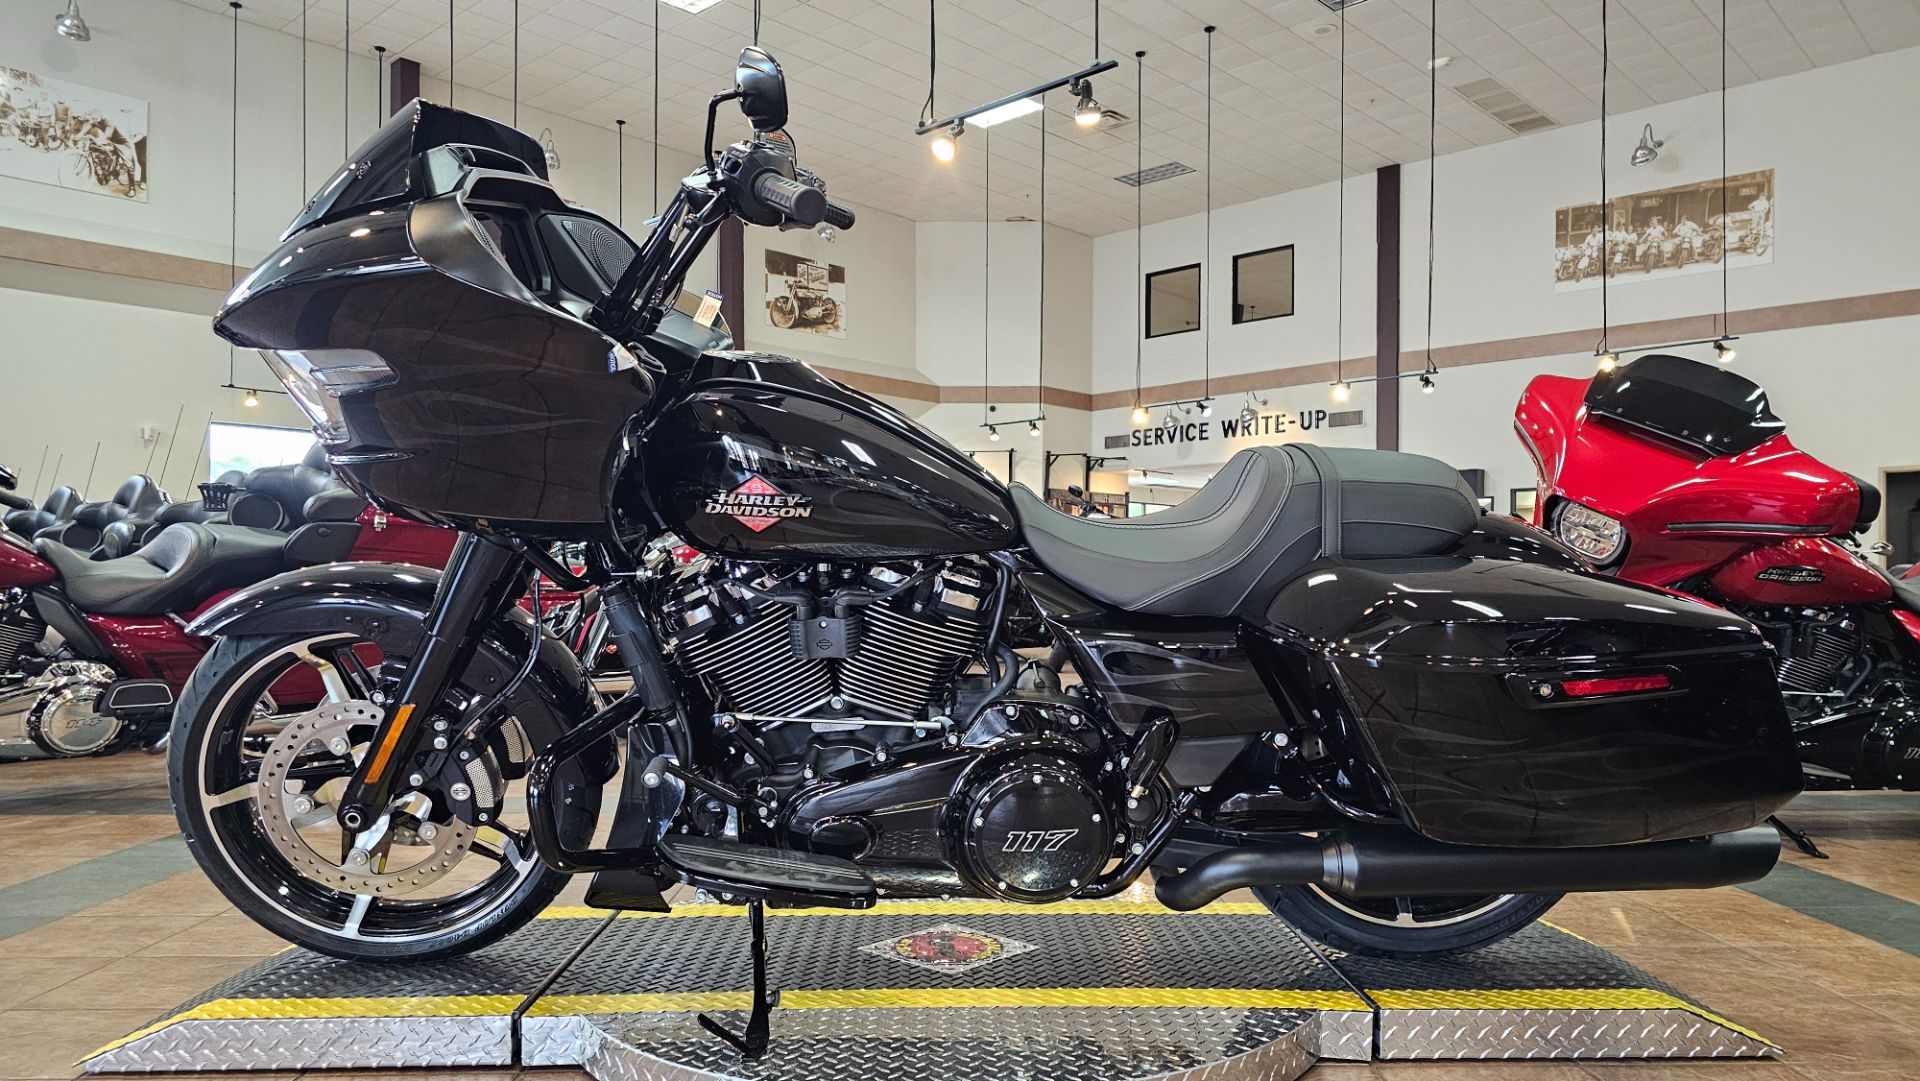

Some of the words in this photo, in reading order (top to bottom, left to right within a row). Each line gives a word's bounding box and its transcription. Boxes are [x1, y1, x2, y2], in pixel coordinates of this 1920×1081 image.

[1131, 422, 1209, 447] SERVICE
[1221, 410, 1328, 439] WRITE-UP
[705, 503, 811, 518] DAVIDSON
[1002, 828, 1079, 852] 117
